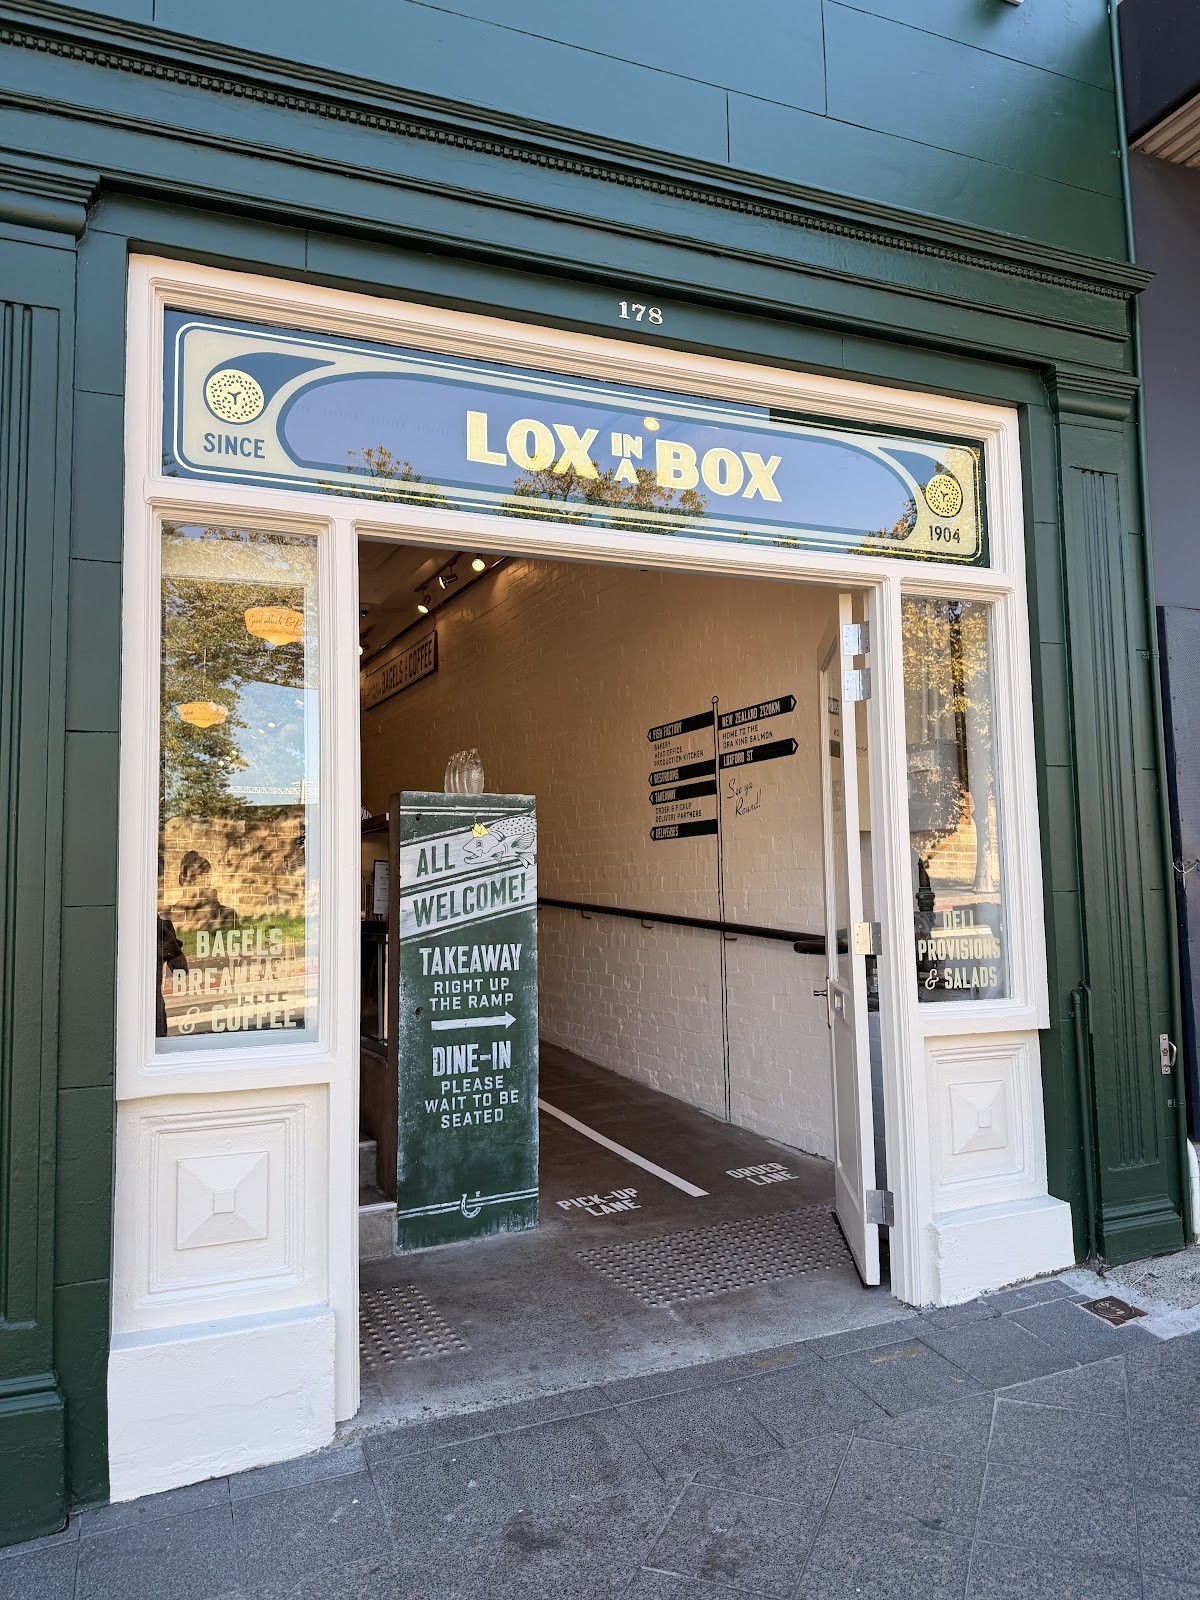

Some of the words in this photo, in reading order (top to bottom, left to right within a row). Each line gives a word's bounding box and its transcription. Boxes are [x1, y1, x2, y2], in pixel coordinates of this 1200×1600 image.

[618, 300, 663, 325] 178
[203, 432, 266, 460] SINCE
[466, 410, 600, 480] LOX
[611, 432, 643, 460] IN
[613, 457, 640, 484] A
[655, 439, 783, 503] BOX
[928, 525, 961, 544] 1904
[381, 659, 403, 695] BAGELS
[408, 638, 433, 678] COFFEE
[721, 713, 734, 728] NEW
[734, 707, 758, 724] ZEALAND
[662, 721, 683, 737] FACTORY
[722, 729, 738, 740] HOME
[739, 727, 746, 736] TO
[747, 724, 759, 734] THE
[735, 736, 748, 746] KING
[749, 730, 773, 743] SALMON
[653, 741, 671, 751] BAKERY
[654, 750, 666, 759] HEAD
[666, 746, 683, 756] OFFICE
[653, 755, 682, 767] PRODUCTION
[683, 749, 704, 761] KITCHEN
[723, 751, 745, 767] LOXFORD
[746, 749, 754, 762] ST
[726, 777, 742, 799] See
[655, 805, 670, 815] ORDER
[655, 812, 677, 823] DELIVERY
[677, 809, 702, 819] PARTNERS
[416, 842, 456, 878] ALL
[413, 872, 526, 928] WELCOME!
[942, 909, 974, 930] DELI
[196, 928, 283, 958] BAGELS
[917, 937, 1001, 961] PROVISIONS
[419, 943, 522, 976] TAKEAWAY
[172, 964, 300, 997] BREAKFA
[433, 978, 484, 995] RIGHT
[489, 977, 510, 991] UP
[924, 968, 940, 990] &
[943, 965, 998, 990] SALADS
[429, 996, 462, 1012] THE
[468, 993, 514, 1009] RAMP
[211, 1001, 297, 1033] COFFEE
[432, 1040, 512, 1077] DINE-IN
[441, 1075, 504, 1095] PLEASE
[424, 1095, 467, 1114] WAIT
[472, 1093, 492, 1108] TO
[499, 1090, 519, 1104] BE
[440, 1108, 504, 1129] SEATED
[725, 1162, 789, 1179] ORDER
[745, 1170, 800, 1186] LANE
[556, 1187, 639, 1211] PICK-UP
[584, 1199, 643, 1217] LANE
